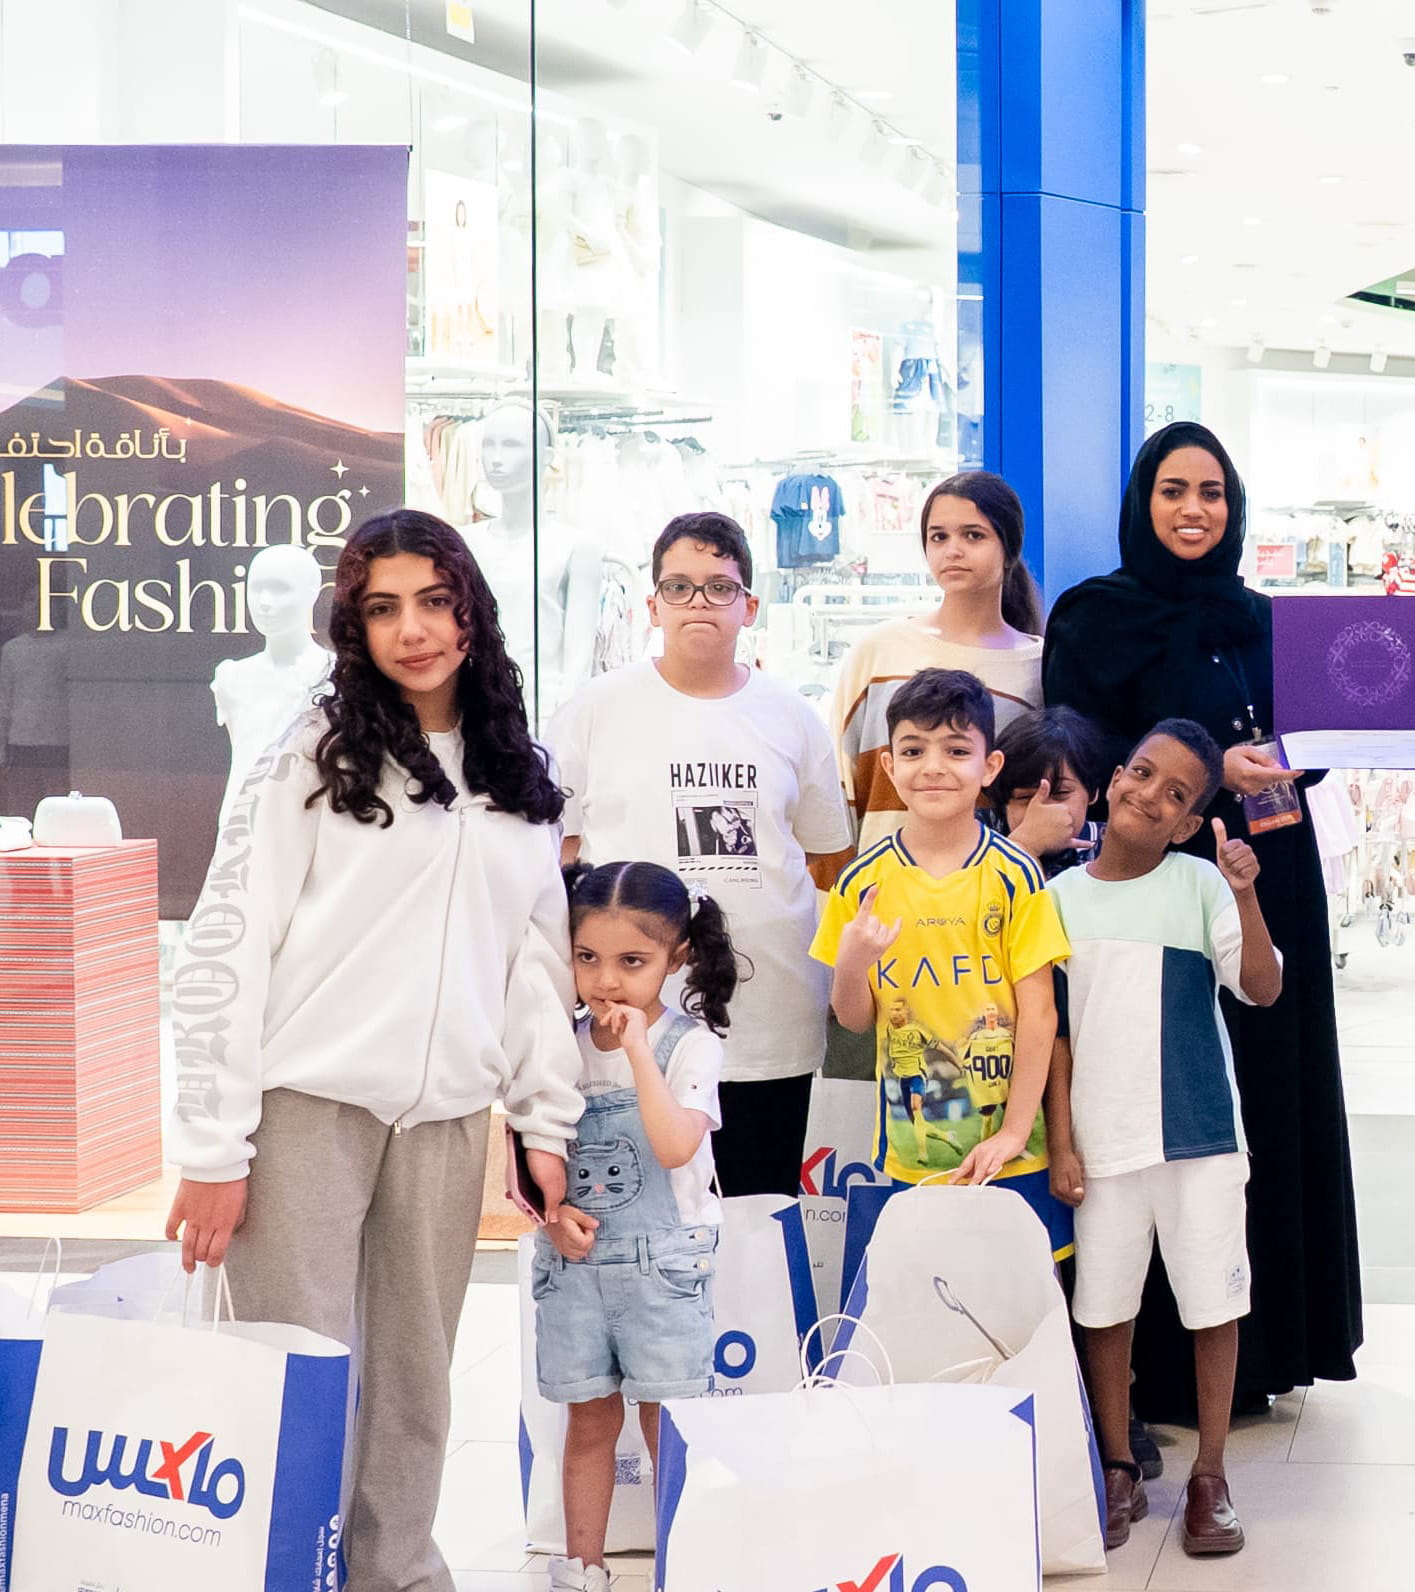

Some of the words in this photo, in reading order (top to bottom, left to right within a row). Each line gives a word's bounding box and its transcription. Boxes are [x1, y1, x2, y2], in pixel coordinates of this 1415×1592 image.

[0, 429, 82, 458] احتف
[86, 428, 187, 463] بأناقة
[972, 1054, 1011, 1081] 900
[62, 1500, 222, 1547] maxfashion.com
